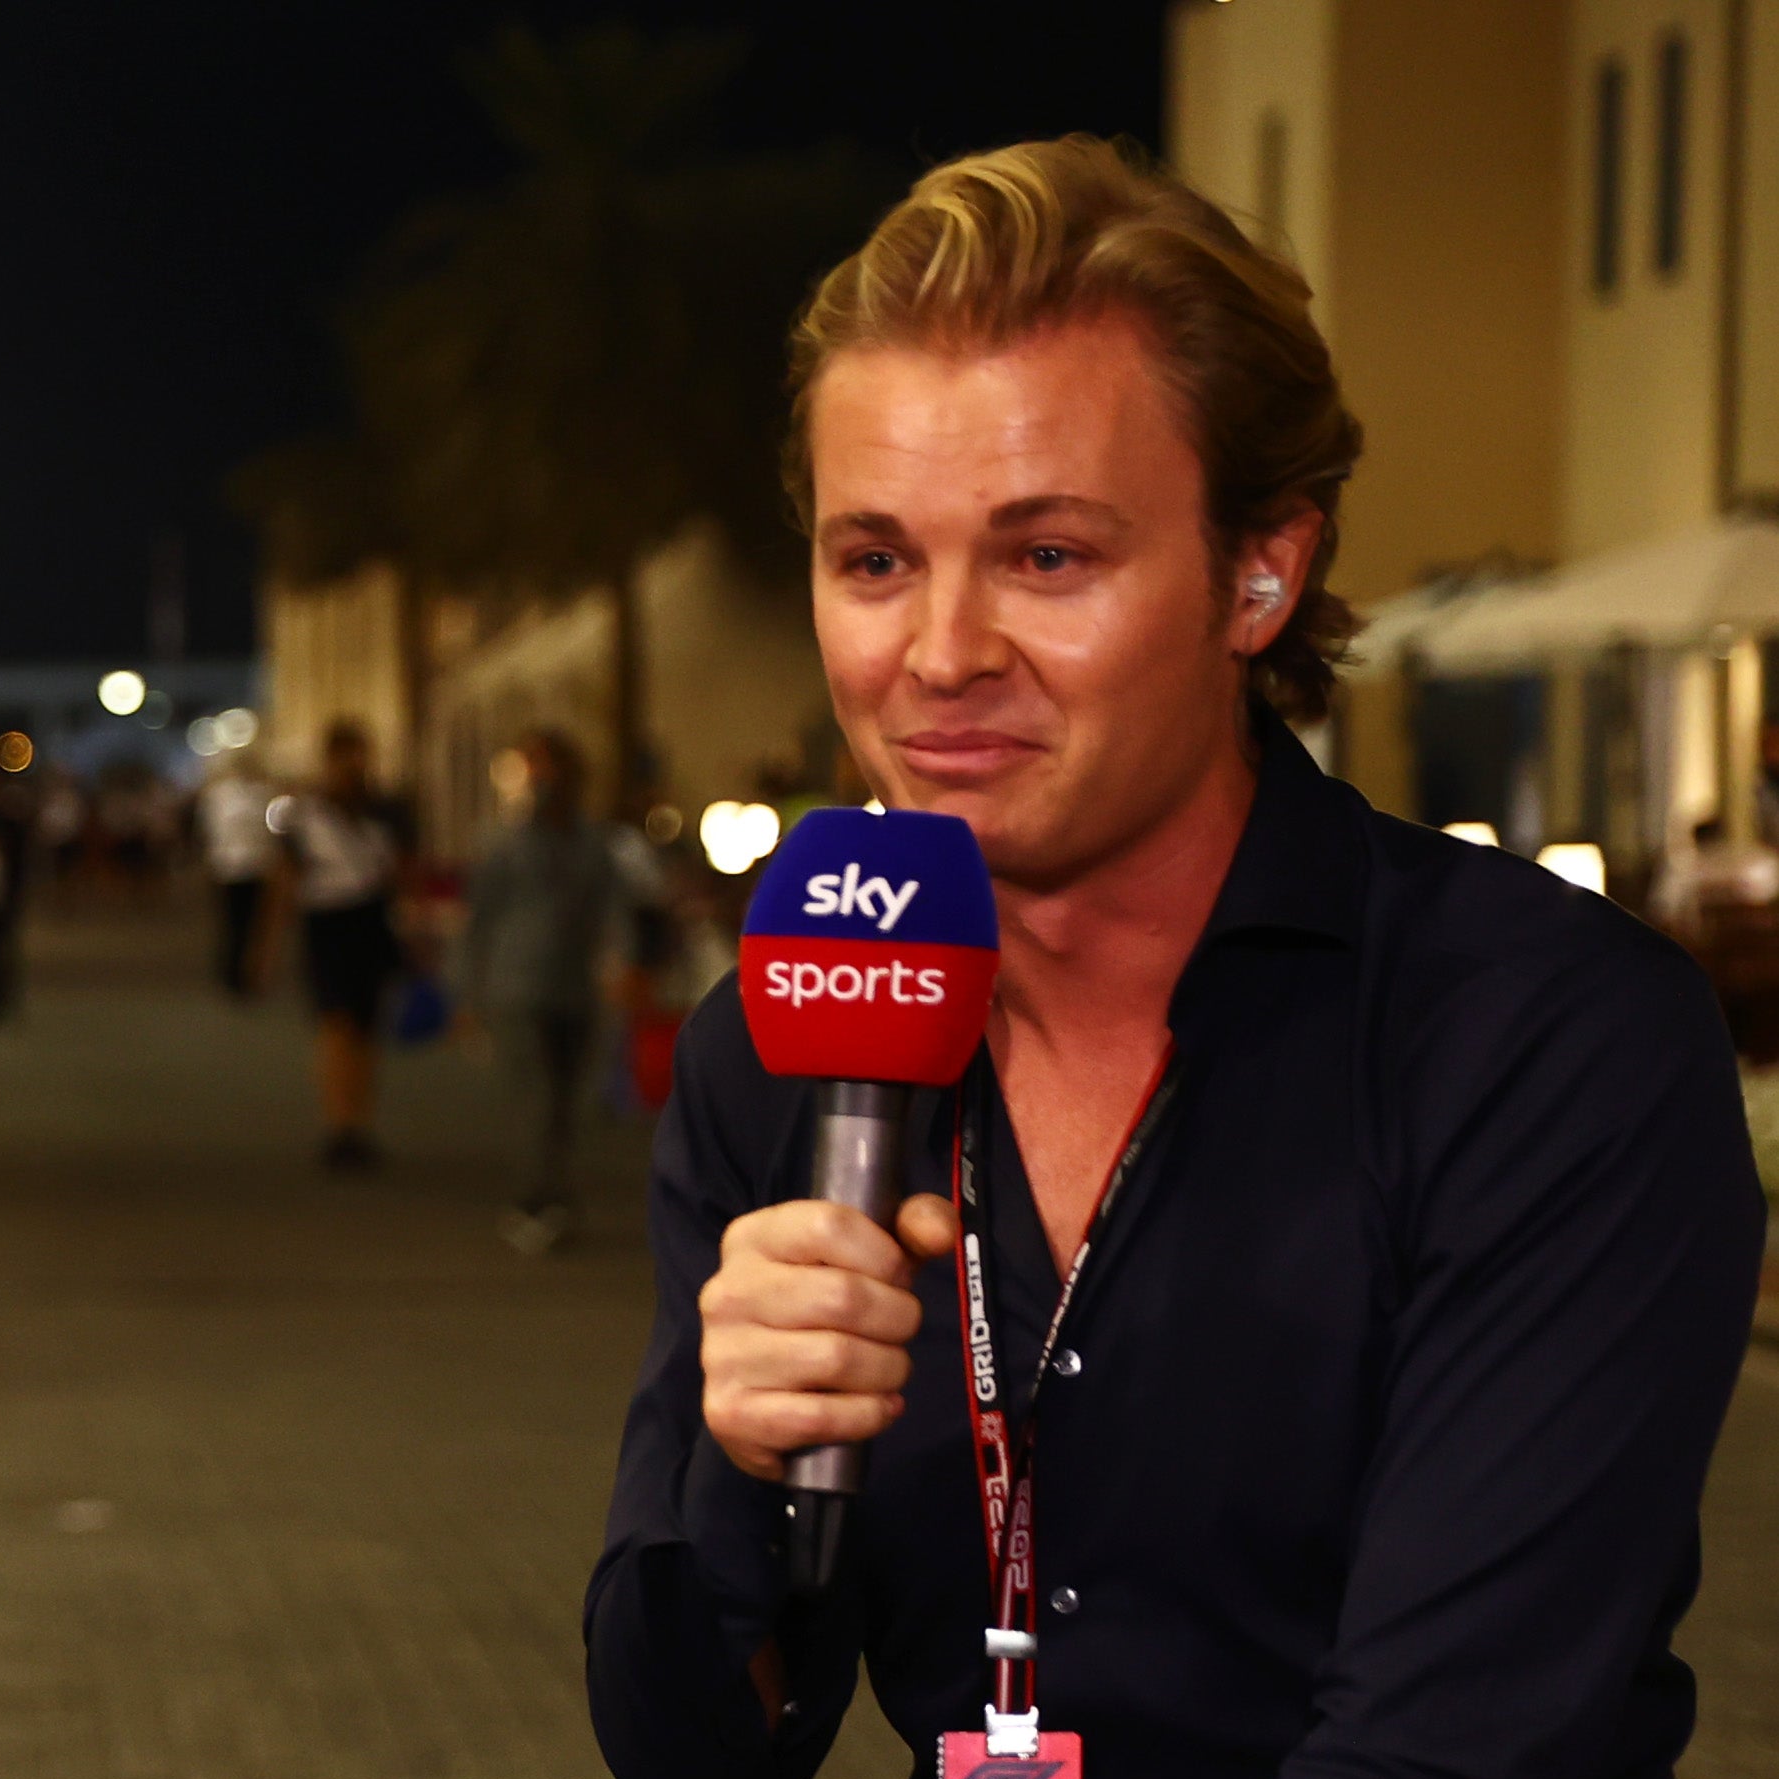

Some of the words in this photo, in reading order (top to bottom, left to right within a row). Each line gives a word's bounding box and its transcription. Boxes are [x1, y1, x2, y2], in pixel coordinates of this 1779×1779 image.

[802, 862, 920, 932] sky
[764, 960, 946, 1009] sports
[970, 1319, 997, 1402] GRID
